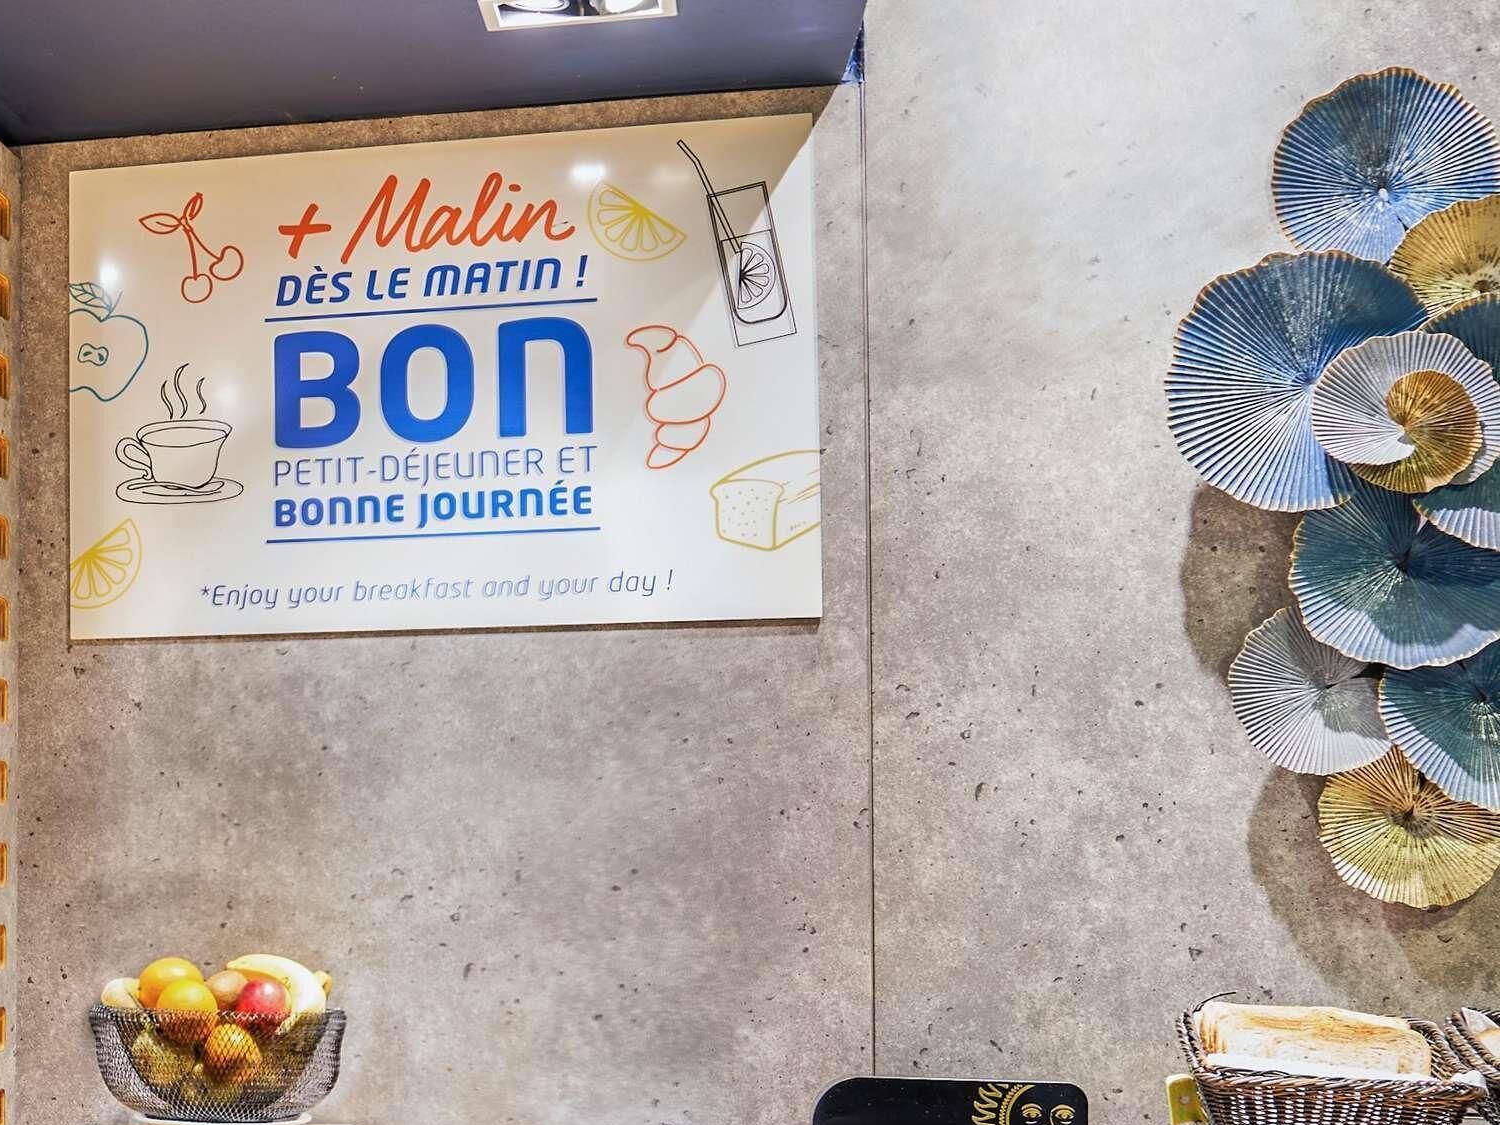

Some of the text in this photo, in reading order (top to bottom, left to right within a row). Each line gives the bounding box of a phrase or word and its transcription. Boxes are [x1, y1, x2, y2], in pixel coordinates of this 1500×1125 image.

[278, 172, 575, 264] + Malin
[276, 255, 589, 306] DÈS LE MATIN !
[274, 317, 593, 448] BON
[275, 446, 597, 486] PETIT-DÉJEUNER ET
[275, 480, 592, 528] BONNE JOURNÉE
[287, 583, 344, 608] your
[354, 577, 473, 602] breakfast
[482, 574, 530, 598] and
[539, 576, 599, 600] your
[609, 570, 657, 596] day
[665, 569, 674, 591] !
